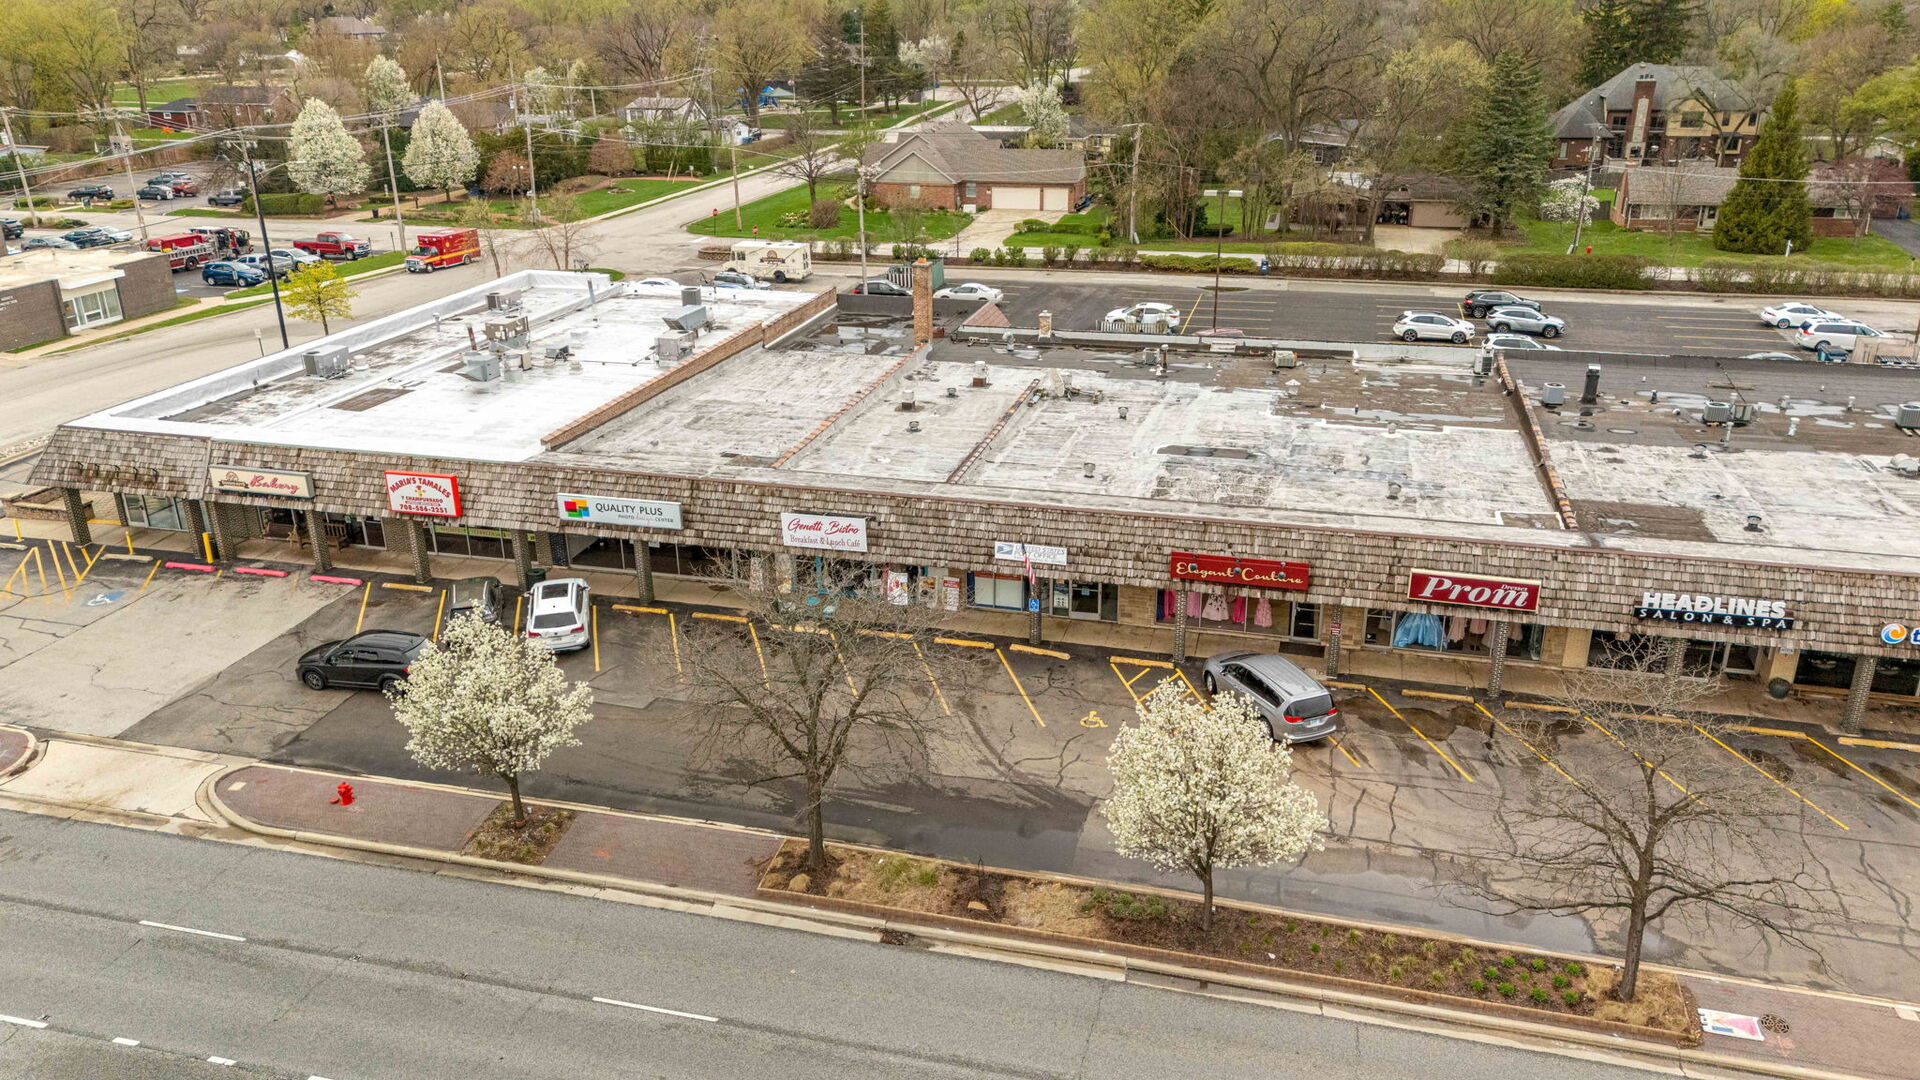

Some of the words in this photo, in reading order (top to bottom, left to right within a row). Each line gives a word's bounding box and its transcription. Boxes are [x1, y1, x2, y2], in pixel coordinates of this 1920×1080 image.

[249, 475, 299, 495] Bakery
[390, 477, 417, 493] MARIA'S
[418, 477, 451, 497] TAMALES
[595, 502, 636, 514] QUALITY
[639, 506, 663, 517] PLUS
[825, 520, 860, 536] Bistro
[790, 534, 819, 545] Breakfast
[1015, 544, 1041, 553] UITED
[1042, 546, 1065, 556] STATES
[1418, 576, 1529, 608] Prom
[1641, 592, 1787, 619] HEADLINES
[1639, 608, 1713, 623] SALON
[1723, 615, 1733, 625] &
[1746, 617, 1787, 629] SPA
